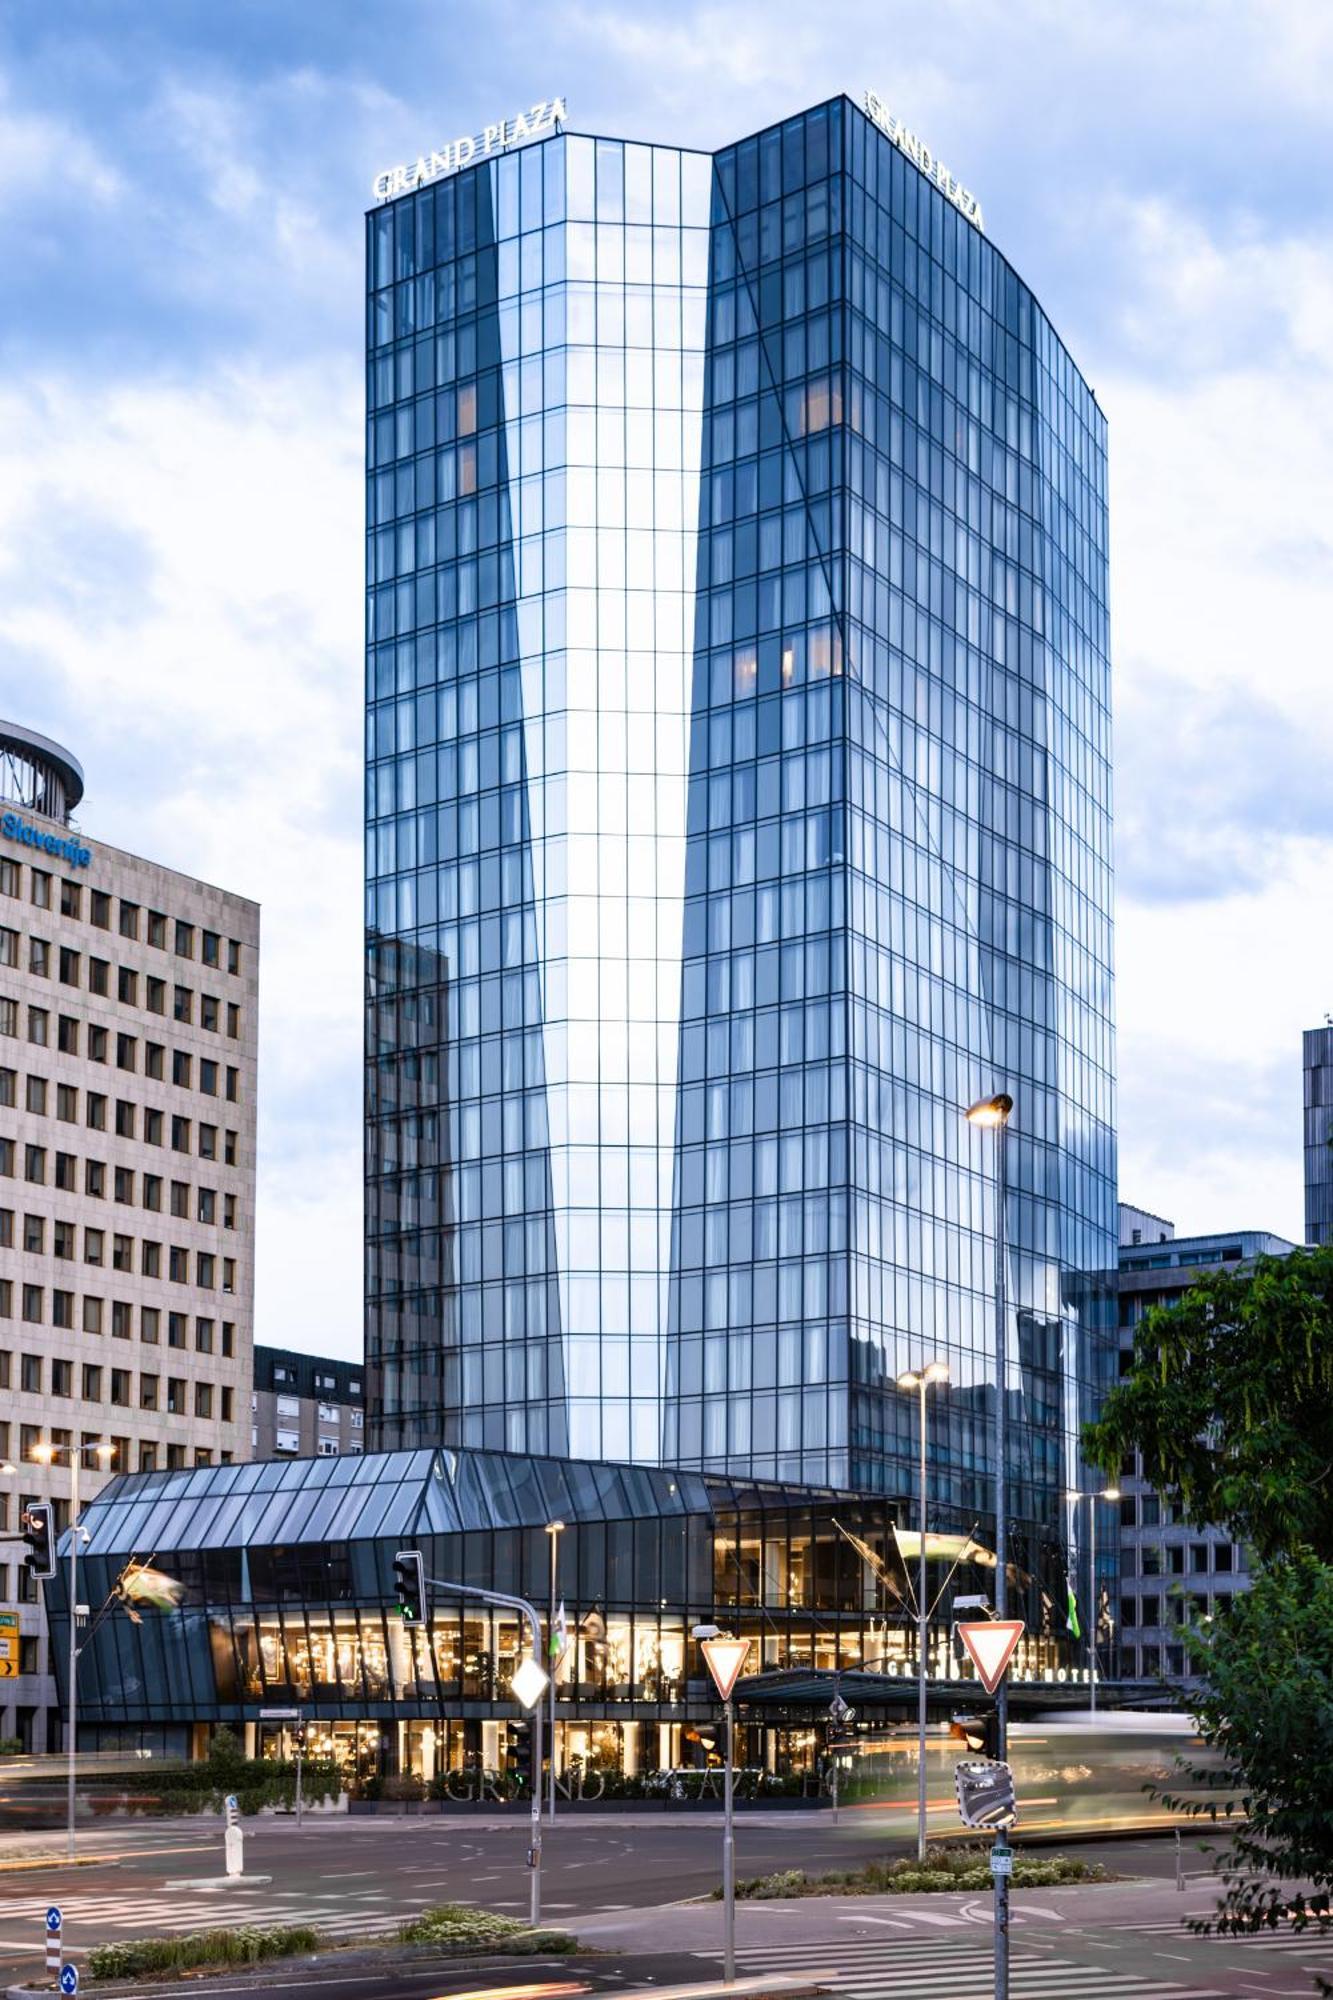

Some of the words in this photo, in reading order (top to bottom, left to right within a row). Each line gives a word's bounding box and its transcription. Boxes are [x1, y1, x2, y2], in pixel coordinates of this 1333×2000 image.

[373, 137, 475, 198] GRAND
[484, 97, 567, 153] PLAZA
[867, 88, 933, 174] GRAND
[2, 812, 91, 869] Slovenije
[1044, 1668, 1099, 1684] HOTEL
